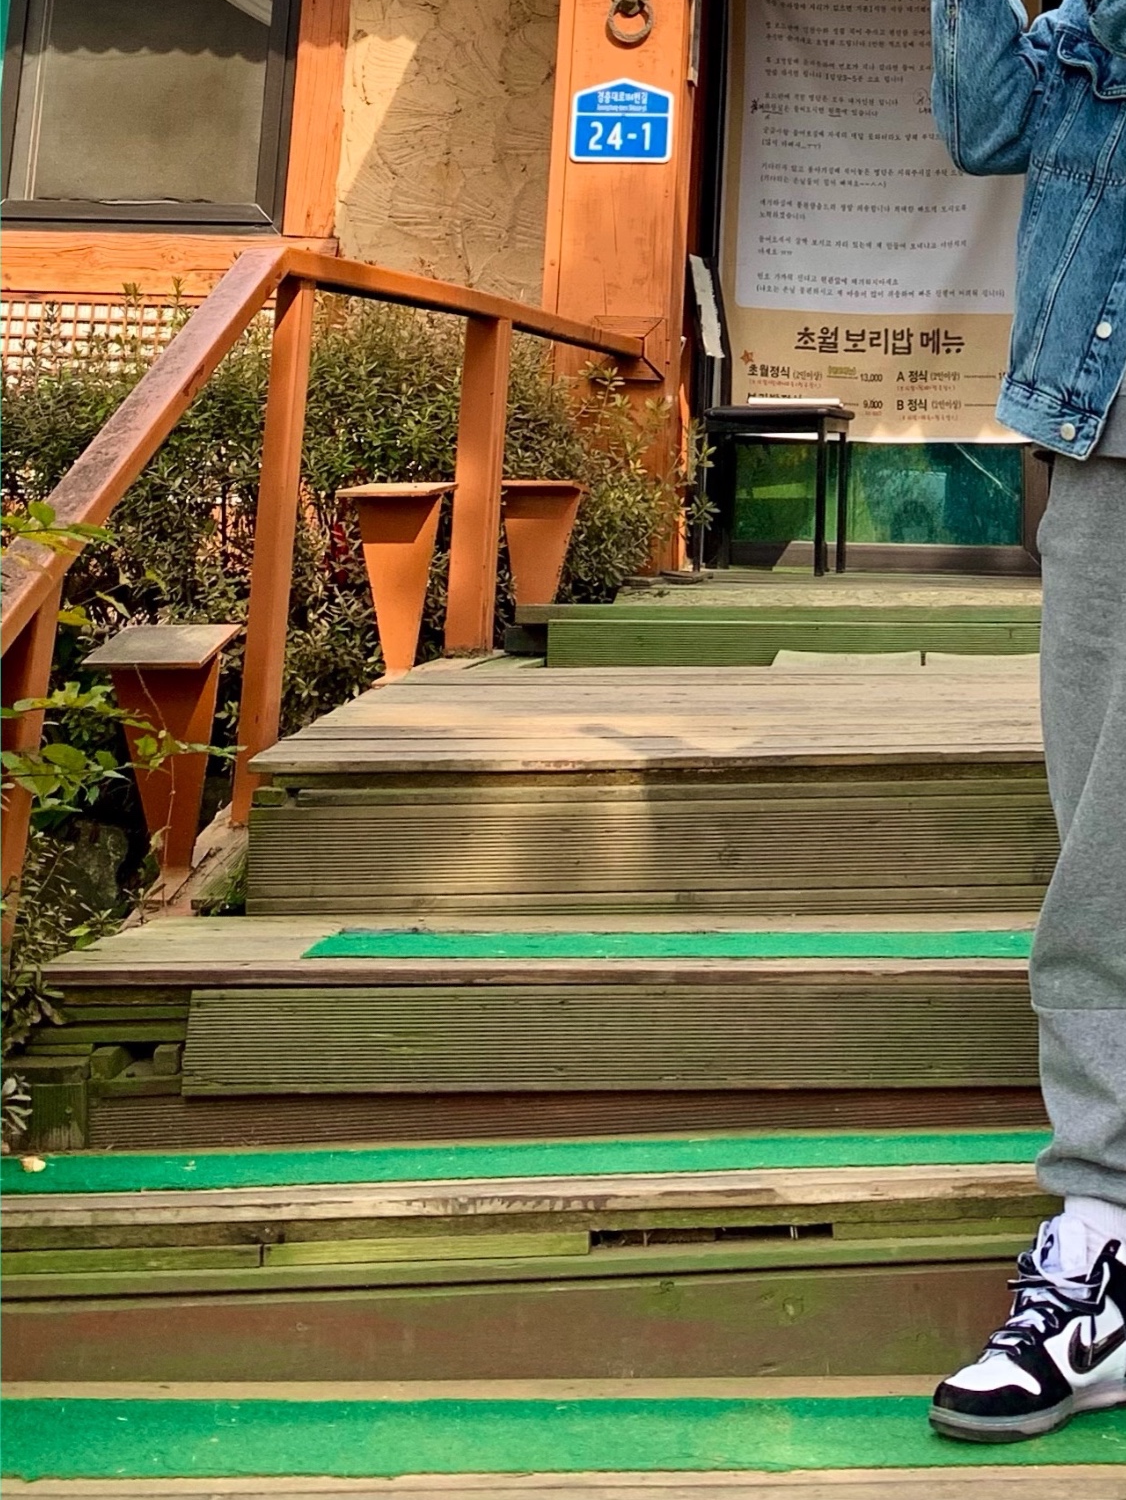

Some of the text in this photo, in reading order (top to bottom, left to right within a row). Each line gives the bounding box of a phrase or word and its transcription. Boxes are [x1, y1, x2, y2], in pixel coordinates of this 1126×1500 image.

[588, 121, 651, 151] 24-1
[793, 326, 966, 356] 초월 보리밥 메뉴
[747, 364, 791, 379] 초월정식
[860, 372, 883, 383] 13,000
[896, 371, 905, 382] A
[908, 370, 928, 383] 정식
[896, 400, 905, 411] B
[907, 399, 928, 412] 정식
